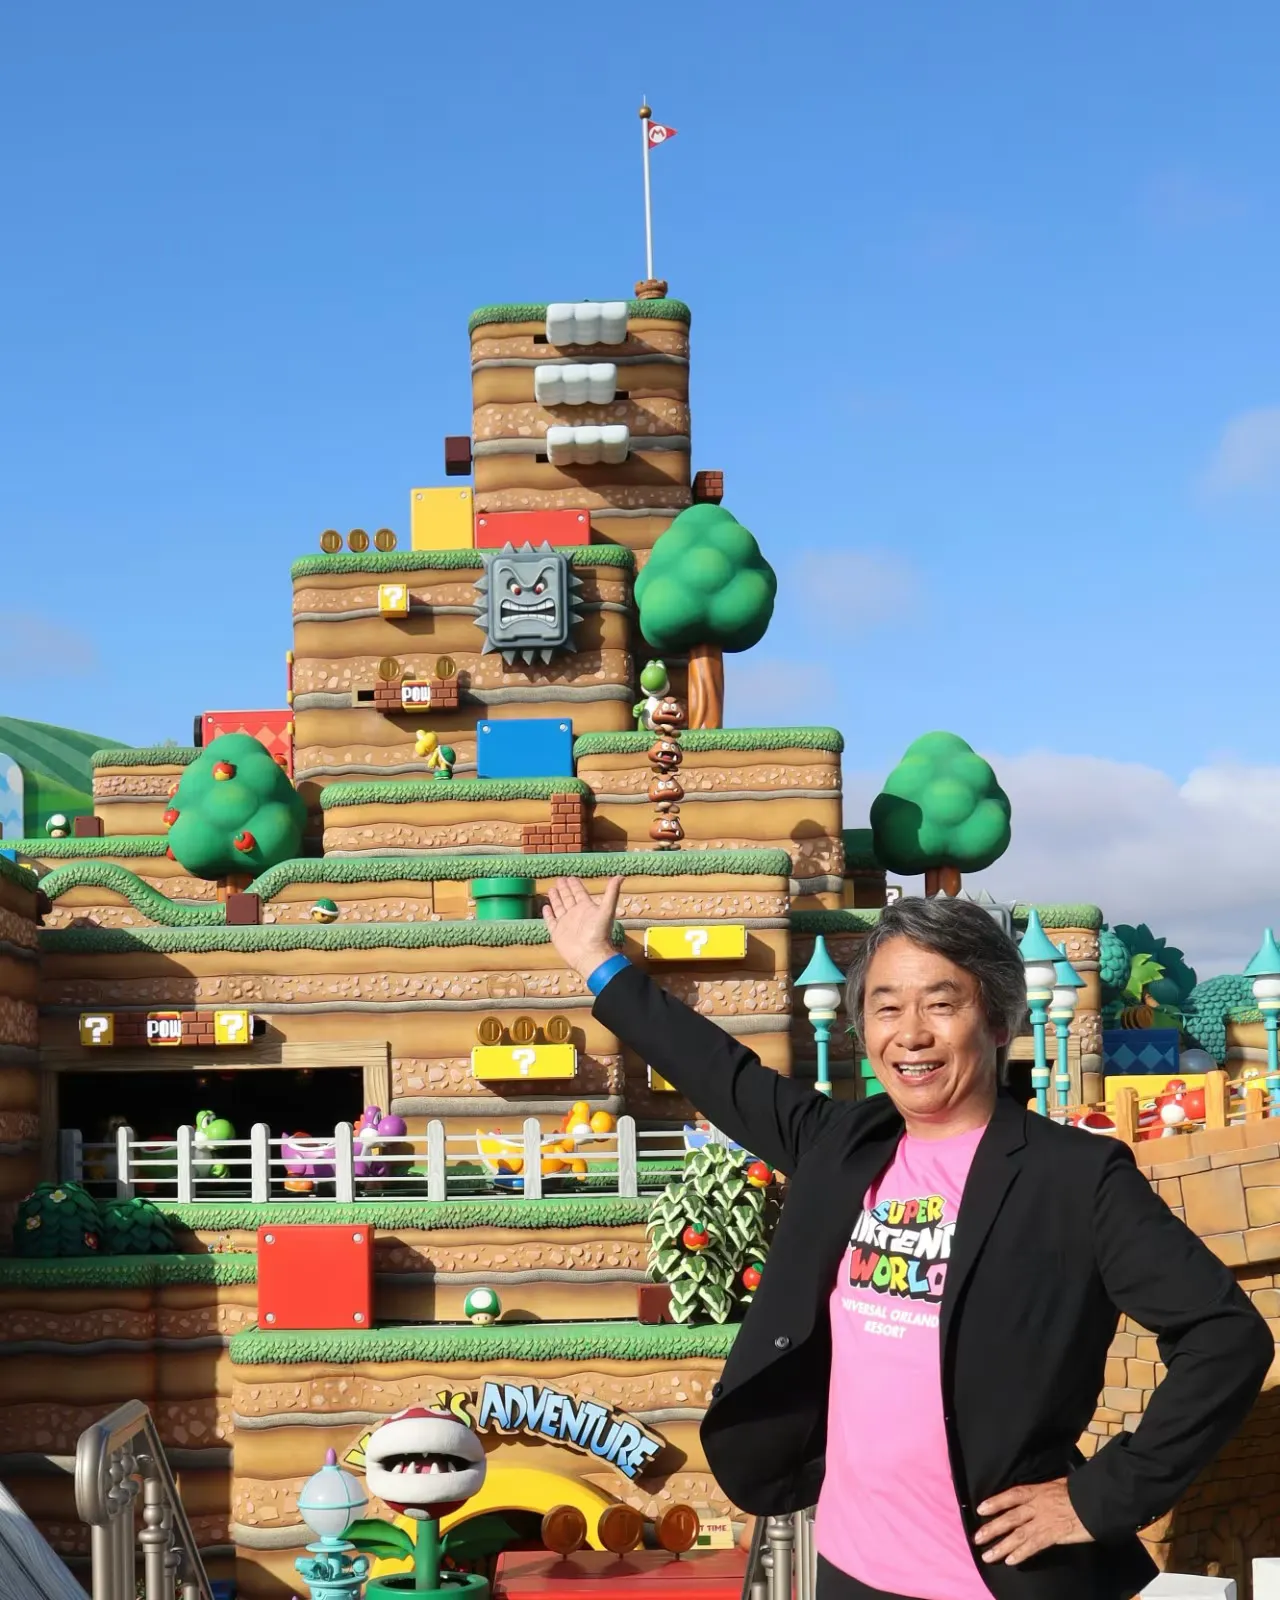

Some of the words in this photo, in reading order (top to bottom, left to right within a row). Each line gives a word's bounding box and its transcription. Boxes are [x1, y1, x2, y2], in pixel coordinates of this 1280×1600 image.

[384, 587, 403, 608] ?
[402, 686, 431, 702] POW
[684, 929, 708, 957] ?
[84, 1016, 109, 1043] ?
[147, 1019, 182, 1039] POW
[219, 1014, 244, 1042] ?
[511, 1047, 537, 1076] ?
[871, 1195, 945, 1226] SUPER
[850, 1248, 948, 1300] WORLD
[841, 1297, 887, 1319] NIVERSAL
[889, 1308, 939, 1328] ORLAND
[863, 1320, 907, 1339] RESORT
[479, 1381, 660, 1480] ADVENTURE
[706, 1524, 728, 1532] TIME
